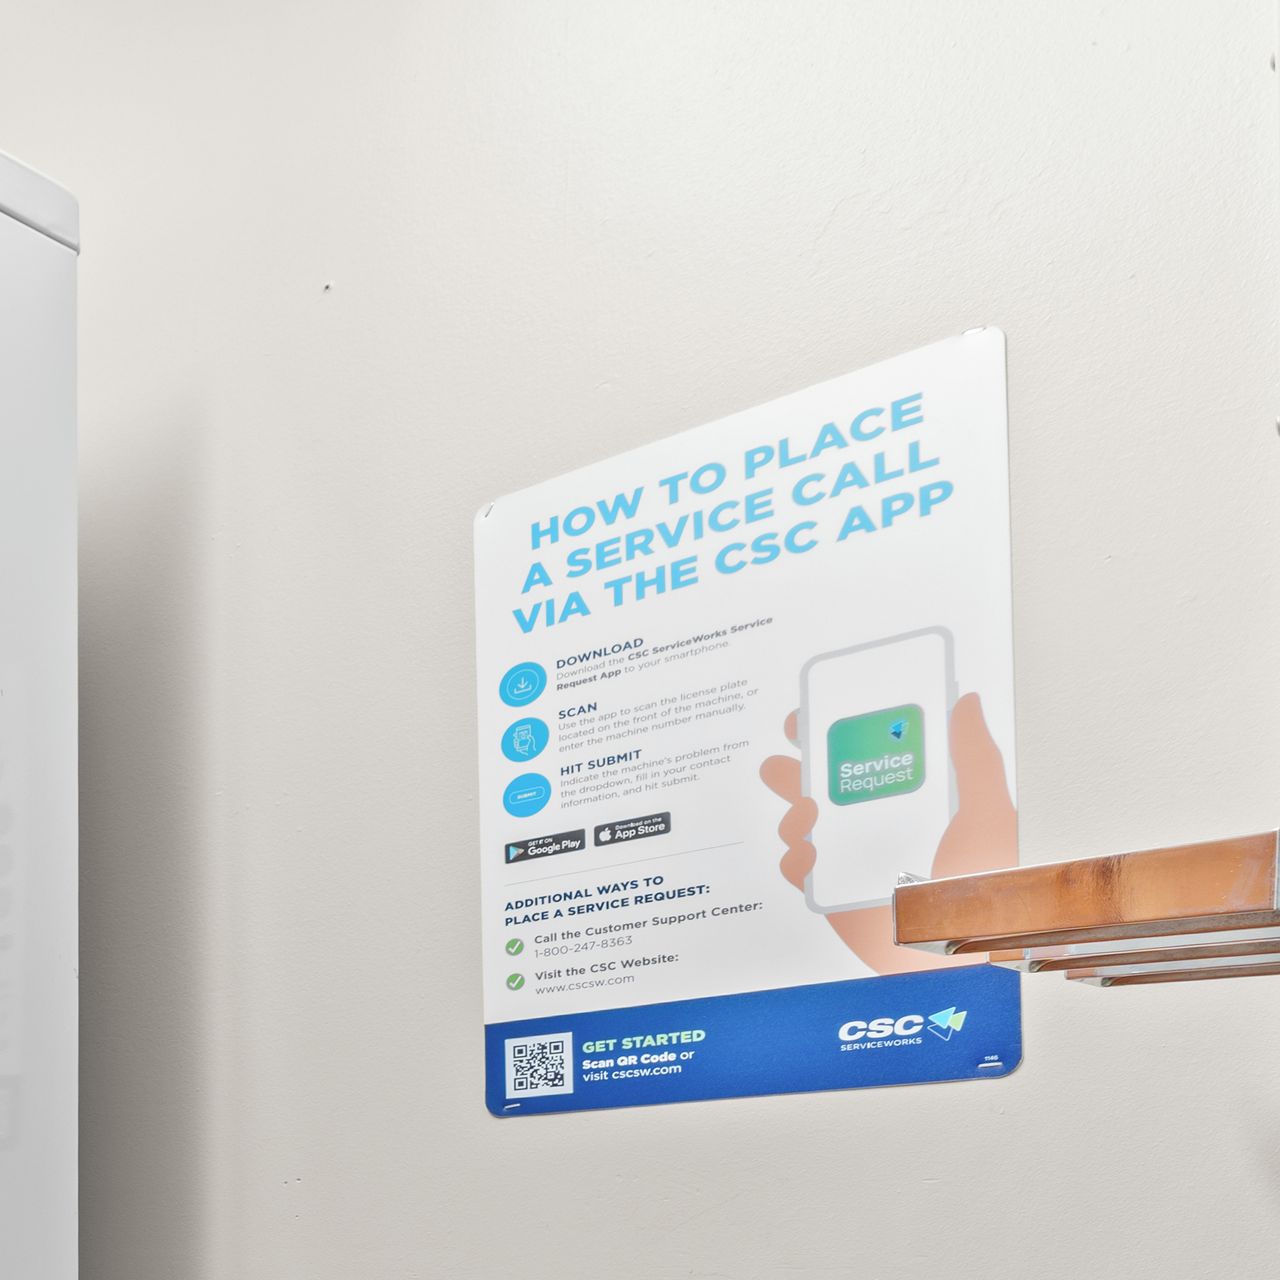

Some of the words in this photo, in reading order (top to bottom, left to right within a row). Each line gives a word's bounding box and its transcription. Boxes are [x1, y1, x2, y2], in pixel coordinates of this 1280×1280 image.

[531, 487, 644, 550] HOW
[659, 462, 726, 505] TO
[745, 392, 923, 480] PLACE
[521, 561, 553, 594] A
[566, 487, 775, 578] SERVICE
[792, 440, 940, 506] CALL
[512, 591, 591, 634] VIA
[604, 555, 699, 607] THE
[715, 520, 818, 574] CSC
[836, 480, 954, 542] APP
[557, 638, 644, 669] DOWNLOAD
[558, 702, 598, 720] SCAN
[561, 764, 583, 776] HIT
[588, 750, 643, 771] SUBMIT
[840, 753, 913, 778] Service
[840, 767, 914, 792] Request
[505, 889, 592, 911] ADDITIONAL
[597, 880, 639, 895] WAYS
[644, 875, 663, 887] TO
[505, 912, 549, 927] PLACE
[554, 909, 563, 918] A
[568, 897, 629, 916] SERVICE
[634, 884, 710, 905] REQUEST:
[535, 933, 557, 944] Call
[561, 929, 581, 939] the
[586, 920, 647, 936] Customer
[652, 910, 707, 927] Support
[711, 900, 763, 917] Center:
[535, 935, 632, 958] 1-800-247-8363
[536, 968, 562, 980] Visit
[566, 965, 585, 976] the
[590, 961, 617, 973] CSC
[621, 952, 679, 969] Website:
[535, 974, 634, 995] www.cscsw.com
[838, 1015, 925, 1041] CSC
[583, 1039, 617, 1053] GET
[622, 1030, 706, 1050] STARTED
[841, 1037, 922, 1051] SERVICEWORKS
[583, 1058, 614, 1069] Scan
[617, 1056, 637, 1066] QR
[641, 1051, 676, 1063] Code
[680, 1051, 694, 1060] or
[583, 1072, 608, 1082] visit
[612, 1064, 682, 1080] cscsw.com
